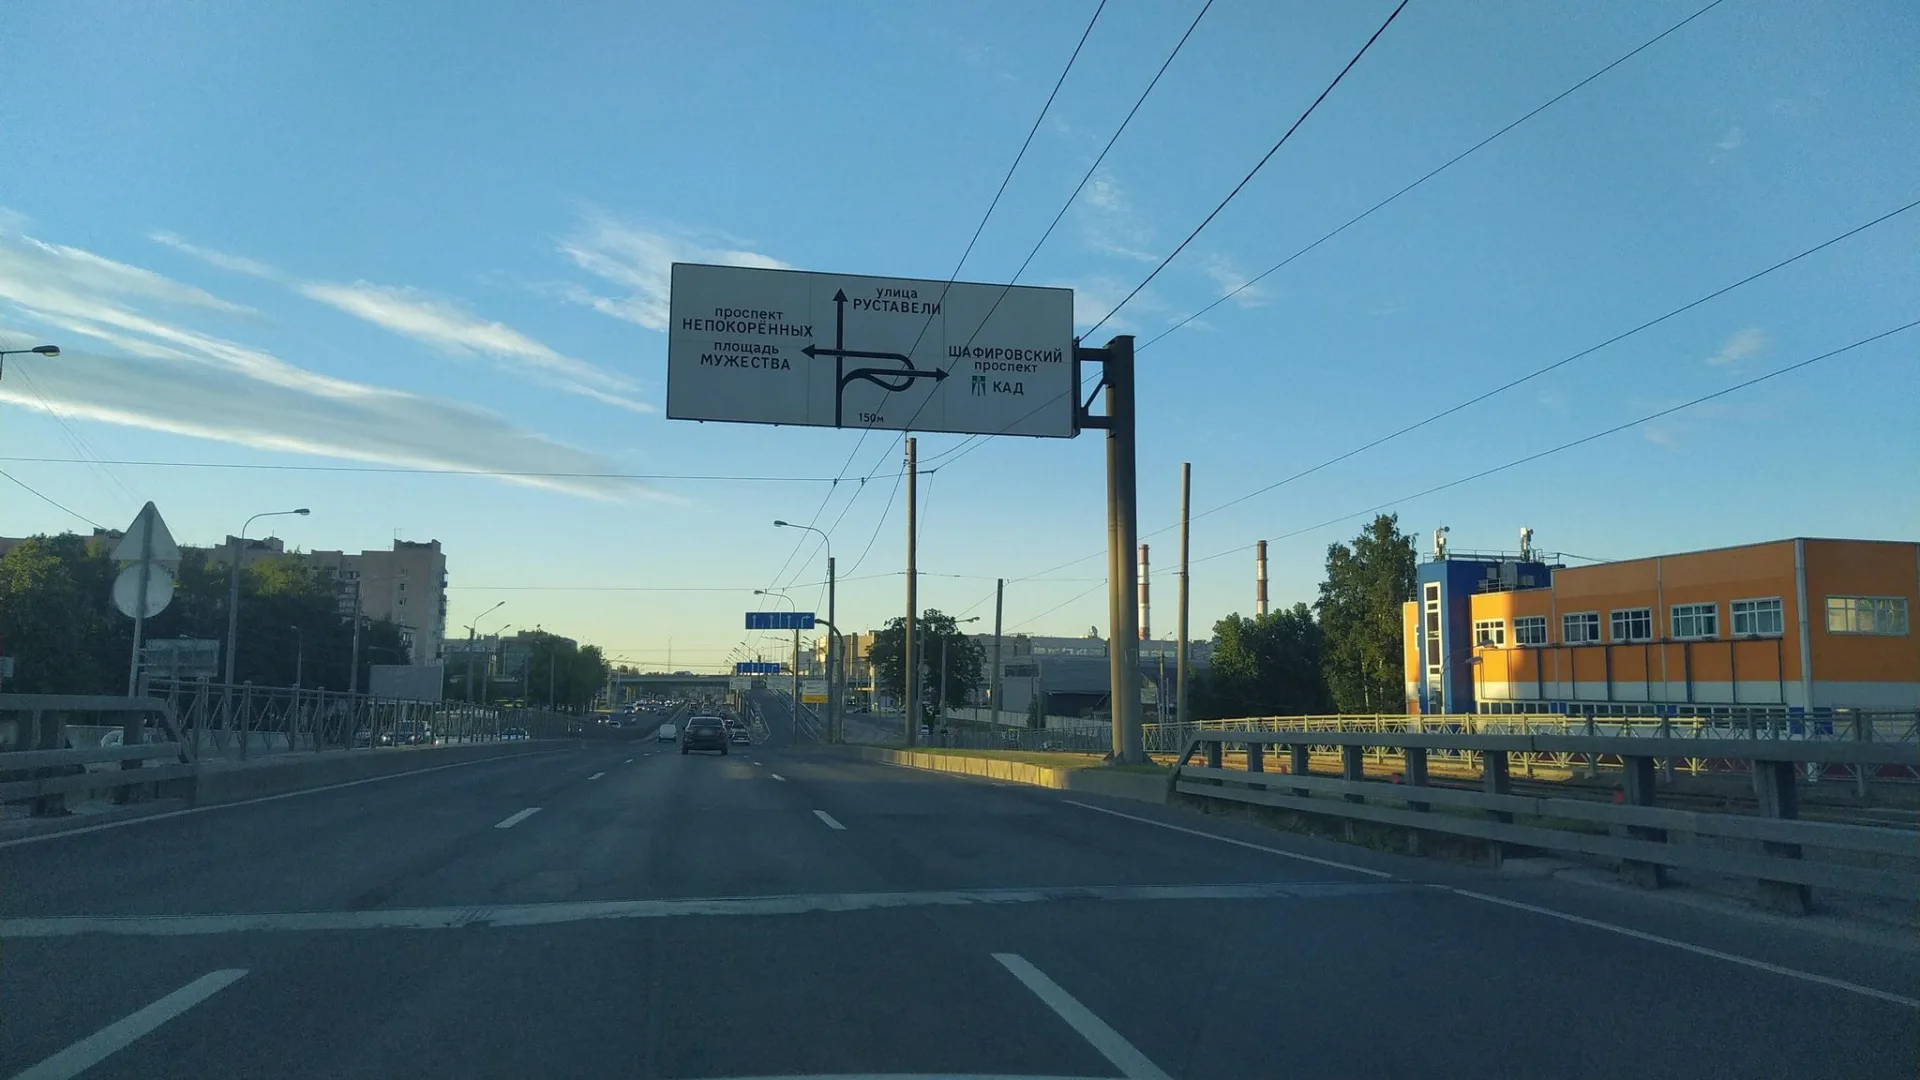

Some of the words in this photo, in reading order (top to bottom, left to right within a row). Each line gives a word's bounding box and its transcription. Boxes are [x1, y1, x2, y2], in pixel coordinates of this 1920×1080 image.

[875, 287, 918, 299] улица
[714, 308, 784, 320] проспект
[853, 298, 941, 315] РУСТАВЕЛИ
[682, 318, 813, 338] НЕПОКОРЁННЫХ
[714, 341, 779, 356] площадь
[948, 345, 1063, 364] ШАФИРОВСКИЙ
[700, 353, 790, 371] МУЖЕСТВА
[974, 361, 1038, 373] проспект
[992, 380, 1024, 396] КАД
